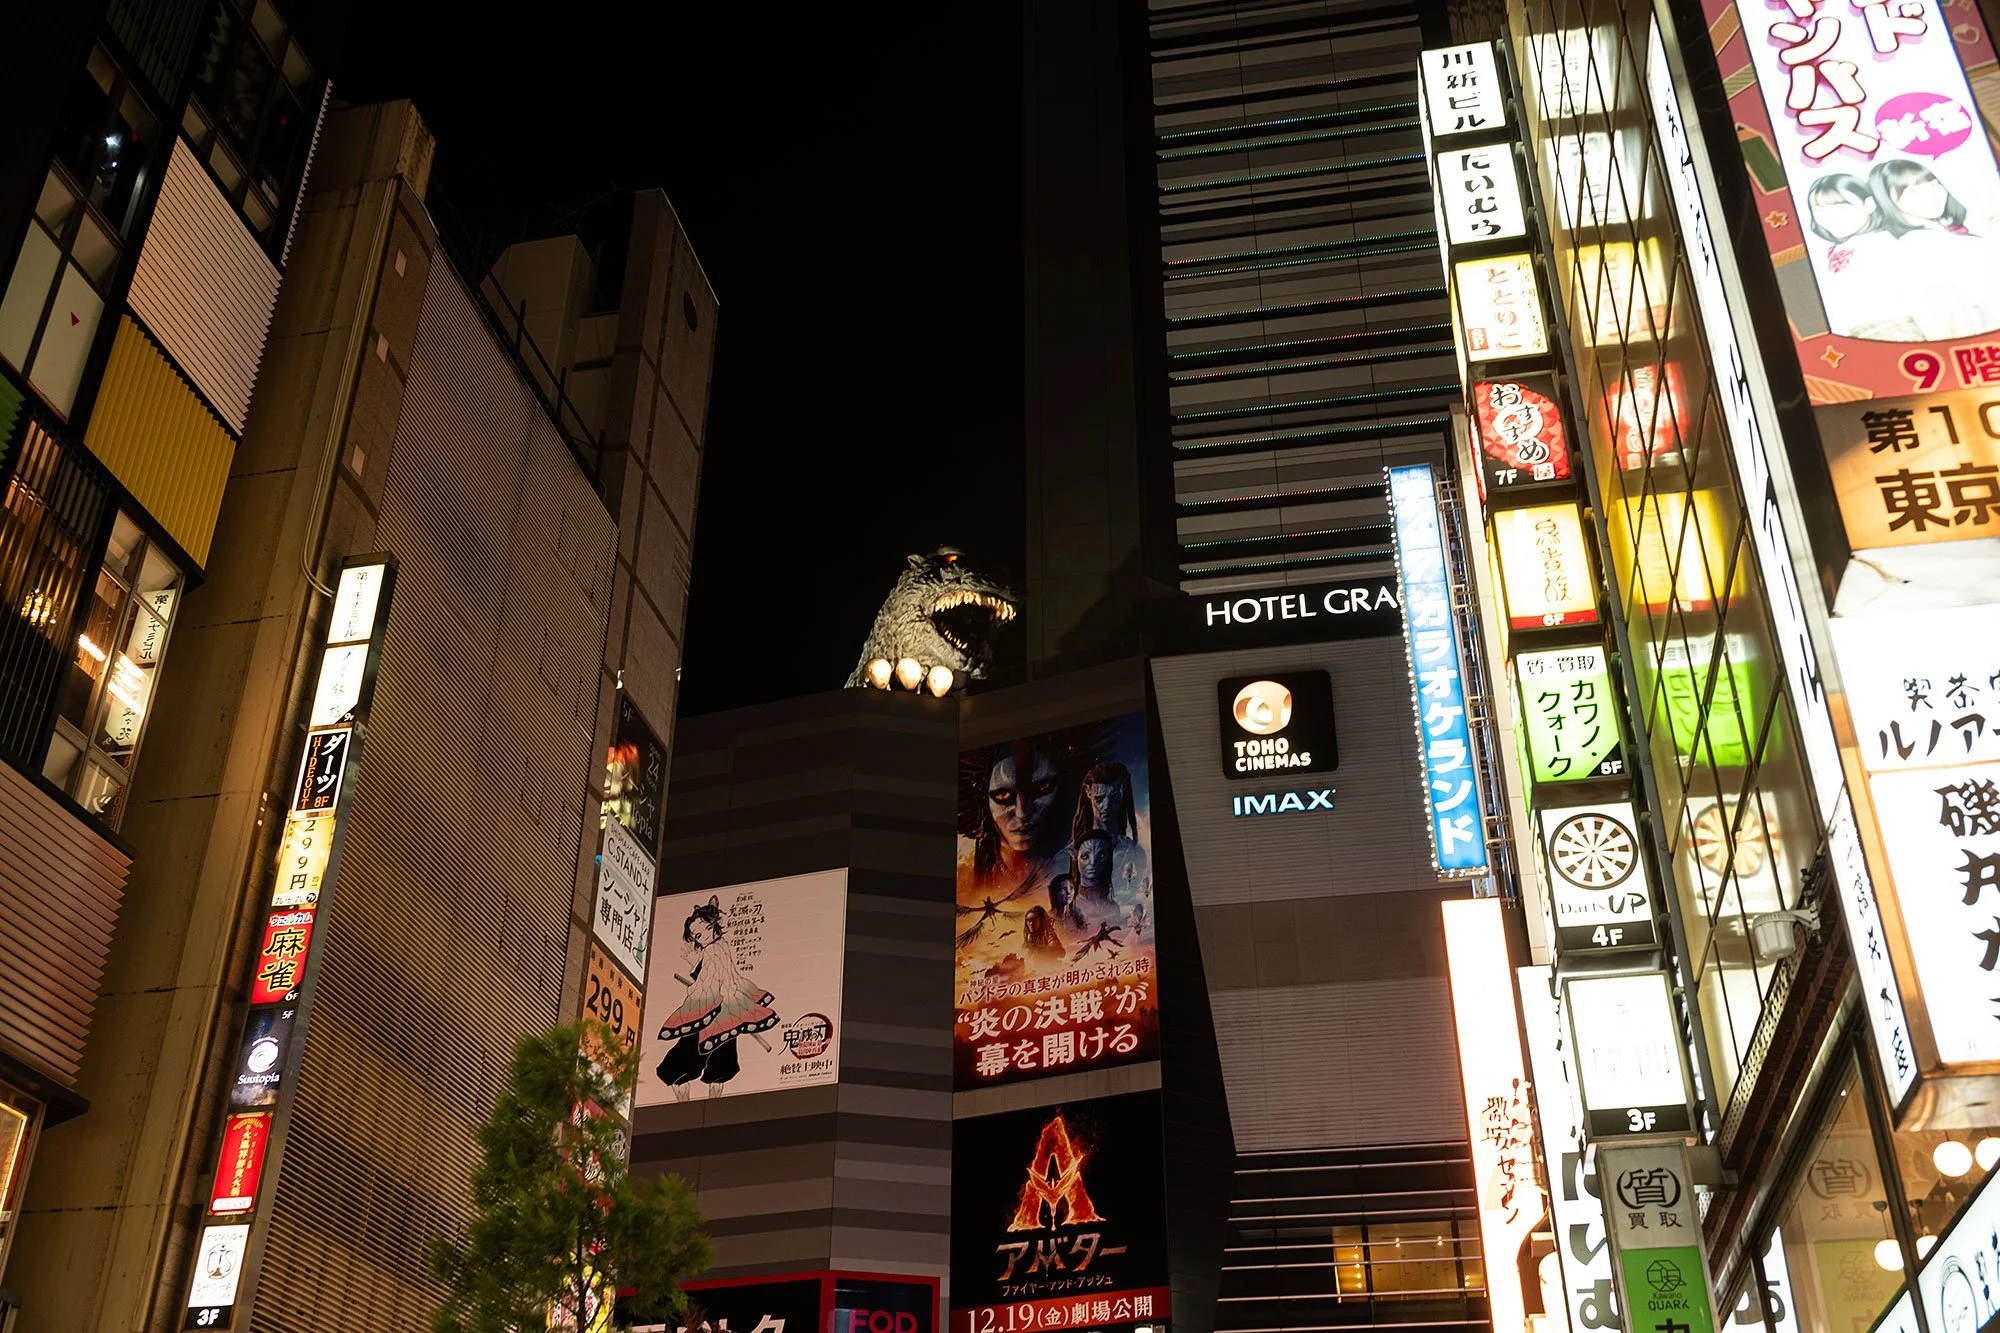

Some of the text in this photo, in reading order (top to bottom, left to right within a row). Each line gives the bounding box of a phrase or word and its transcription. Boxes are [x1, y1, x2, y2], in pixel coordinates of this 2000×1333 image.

[1441, 50, 1486, 130] 川新ビル
[1491, 385, 1548, 462] おすすめ
[1495, 468, 1518, 485] 7F
[1875, 463, 2000, 532] 東京
[1206, 593, 1317, 626] HOTEL
[1542, 612, 1565, 627] 6F
[1903, 669, 2000, 712] 喫茶
[1234, 737, 1290, 757] TOHO
[1537, 691, 1572, 778] クォーク
[301, 736, 323, 810] HIDEOUT
[316, 733, 347, 794] ダーツ
[1235, 752, 1312, 772] CINEMAS
[1601, 760, 1622, 775] 5F
[314, 796, 330, 808] 8F
[1232, 789, 1334, 817] IMAX
[603, 868, 641, 928] シーシャ
[1608, 892, 1647, 914] UP
[270, 912, 314, 927] ウェルカム
[600, 896, 634, 953] 専門店
[1592, 925, 1623, 947] 4F
[259, 927, 306, 992] 麻雀
[959, 957, 1150, 1004] パンドラの真実が明かされる時
[285, 990, 299, 1002] 6F
[281, 1010, 295, 1020] 5F
[976, 1023, 1139, 1077] 幕を開ける
[1626, 1108, 1656, 1132] 3F
[1628, 1211, 1683, 1230] 買取
[995, 1232, 1128, 1282] アバター
[196, 1308, 220, 1326] 3F
[1648, 1300, 1690, 1311] QUARK
